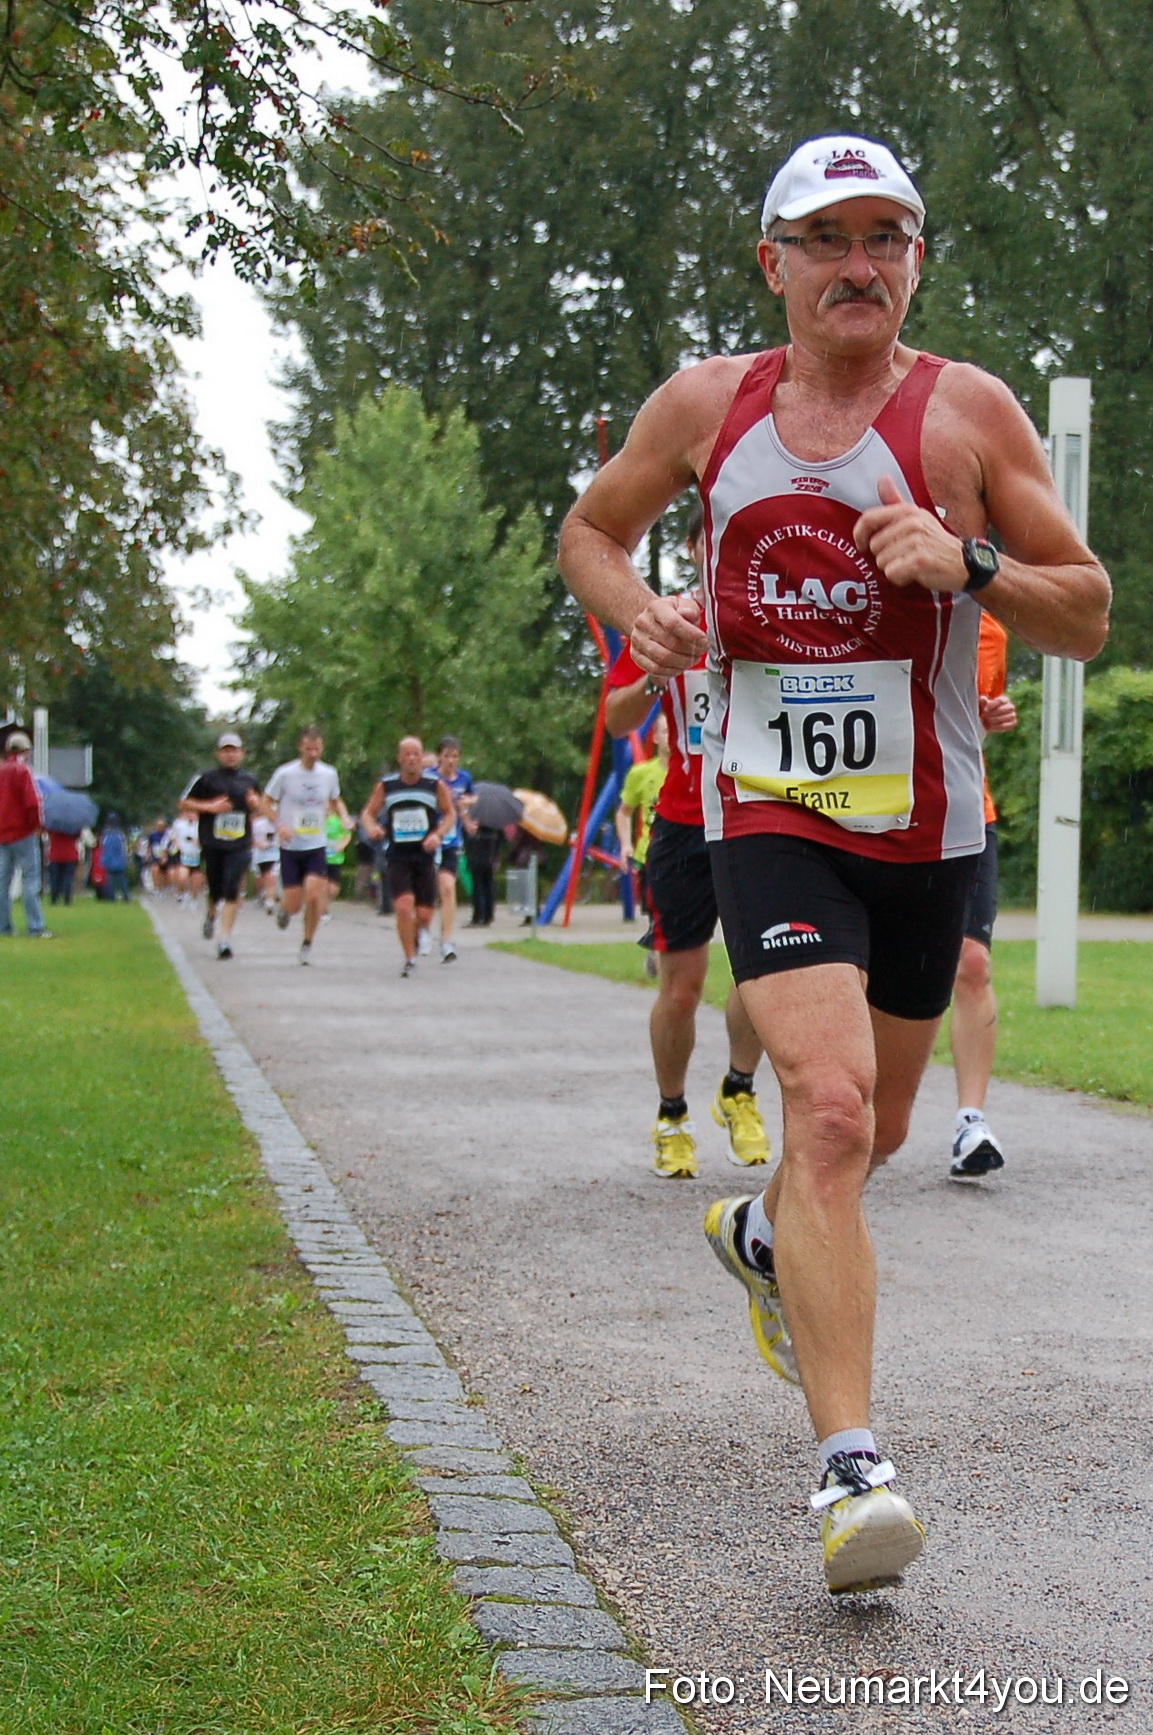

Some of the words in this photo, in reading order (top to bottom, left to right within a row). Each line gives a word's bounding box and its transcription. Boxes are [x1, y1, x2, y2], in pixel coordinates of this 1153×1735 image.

[832, 149, 866, 159] LAC
[747, 524, 857, 627] LEICHTATHLETIK-CLUB
[760, 573, 868, 612] LAC
[776, 607, 854, 625] Harlein
[781, 675, 854, 693] BOCK
[767, 709, 877, 776] 160
[785, 786, 851, 810] Franz
[762, 932, 823, 950] skinfit
